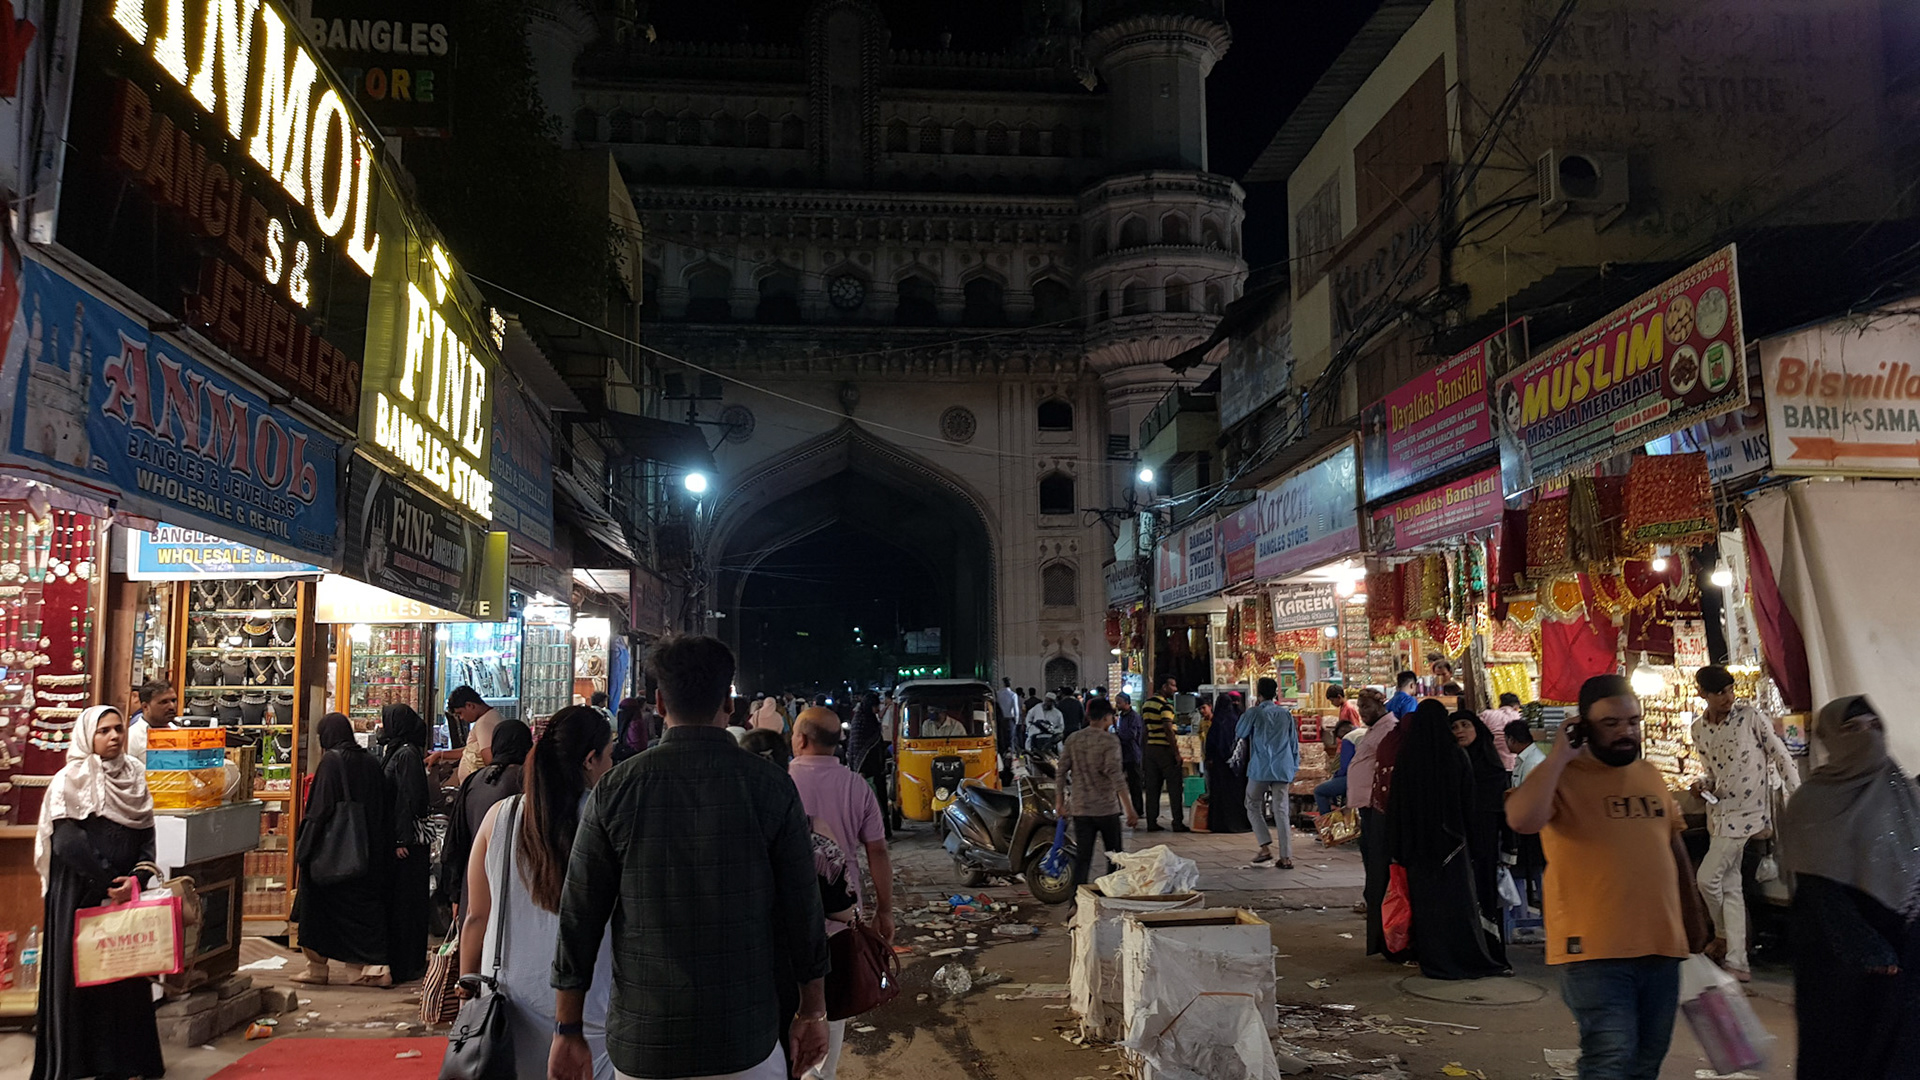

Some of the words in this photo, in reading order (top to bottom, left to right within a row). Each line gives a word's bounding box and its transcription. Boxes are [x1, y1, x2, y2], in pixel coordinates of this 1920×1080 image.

[311, 17, 449, 56] BANGLES
[116, 80, 285, 286] BANGLES
[289, 240, 310, 310] &
[200, 257, 361, 418] JEWELLERS
[1520, 312, 1664, 427] MUSLIM
[400, 281, 486, 460] FINE
[1391, 390, 1436, 436] Dayaldas
[1436, 359, 1483, 411] Bansilal
[102, 328, 317, 505] ANMOL
[1527, 408, 1578, 446] MASALA
[1580, 367, 1663, 421] MERCHANT
[1631, 412, 1642, 427] KA
[1642, 401, 1668, 425] SAMAN
[1784, 405, 1840, 429] BARI
[127, 433, 205, 484] BANGLES
[210, 470, 219, 490] &
[223, 474, 296, 520] JEWELLERS
[374, 392, 450, 492] BANGLES
[452, 456, 493, 521] STORE
[136, 466, 233, 521] WHOLESALE
[236, 506, 245, 524] &
[249, 512, 291, 540] REATIL
[390, 496, 434, 561] FINE
[1395, 495, 1443, 525] Dayaldas
[1446, 474, 1497, 506] Bansilal
[149, 528, 221, 544] BANGLES
[157, 548, 251, 565] WHOLESALE
[255, 550, 267, 565] &
[1259, 534, 1286, 558] BANGLES
[1287, 525, 1309, 549] STORE
[1188, 579, 1212, 595] DEALERS
[1274, 596, 1334, 618] KAREEM
[1604, 795, 1666, 820] GAP
